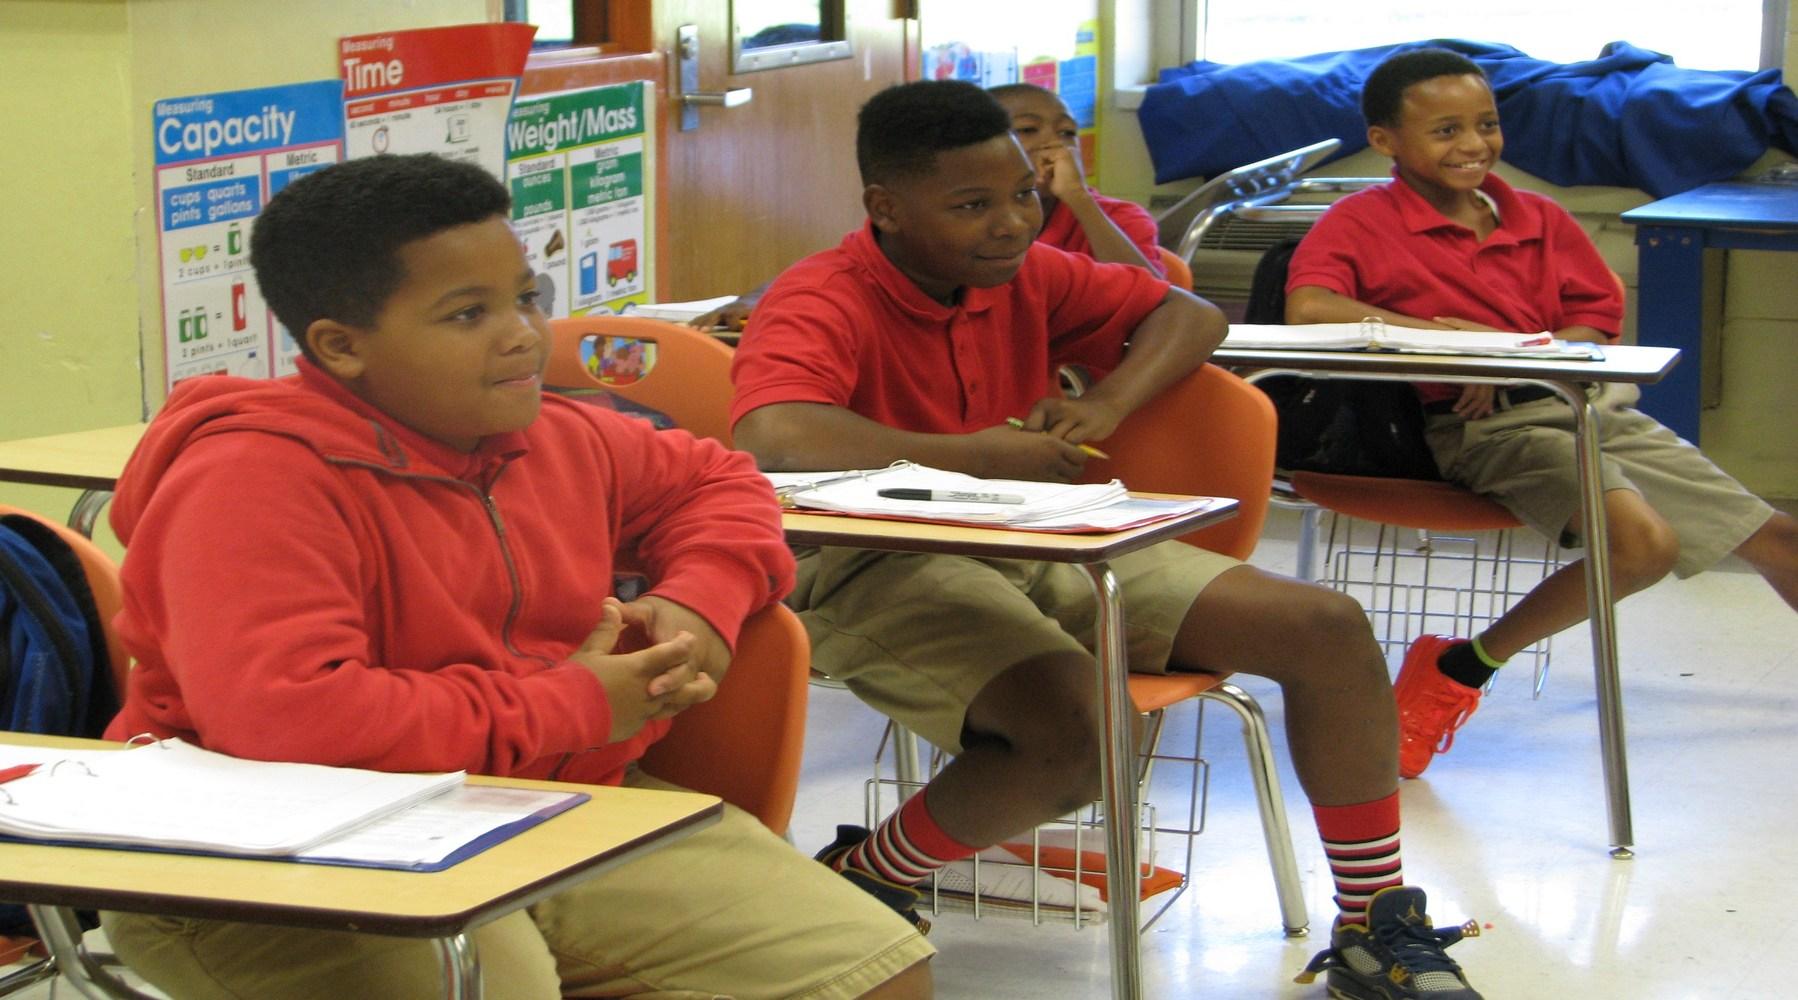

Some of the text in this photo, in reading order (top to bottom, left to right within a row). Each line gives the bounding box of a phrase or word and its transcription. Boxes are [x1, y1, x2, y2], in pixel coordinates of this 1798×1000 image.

[342, 37, 394, 53] Measuring
[344, 58, 404, 91] Time
[157, 99, 213, 117] Measuring
[512, 102, 550, 117] easuring
[159, 105, 295, 156] Capacity
[508, 106, 637, 152] Weight/Mass
[286, 151, 318, 167] Metric
[518, 159, 555, 175] Standard
[186, 163, 234, 182] Standard
[171, 182, 246, 207] cups quarts
[171, 199, 252, 226] pints gallons
